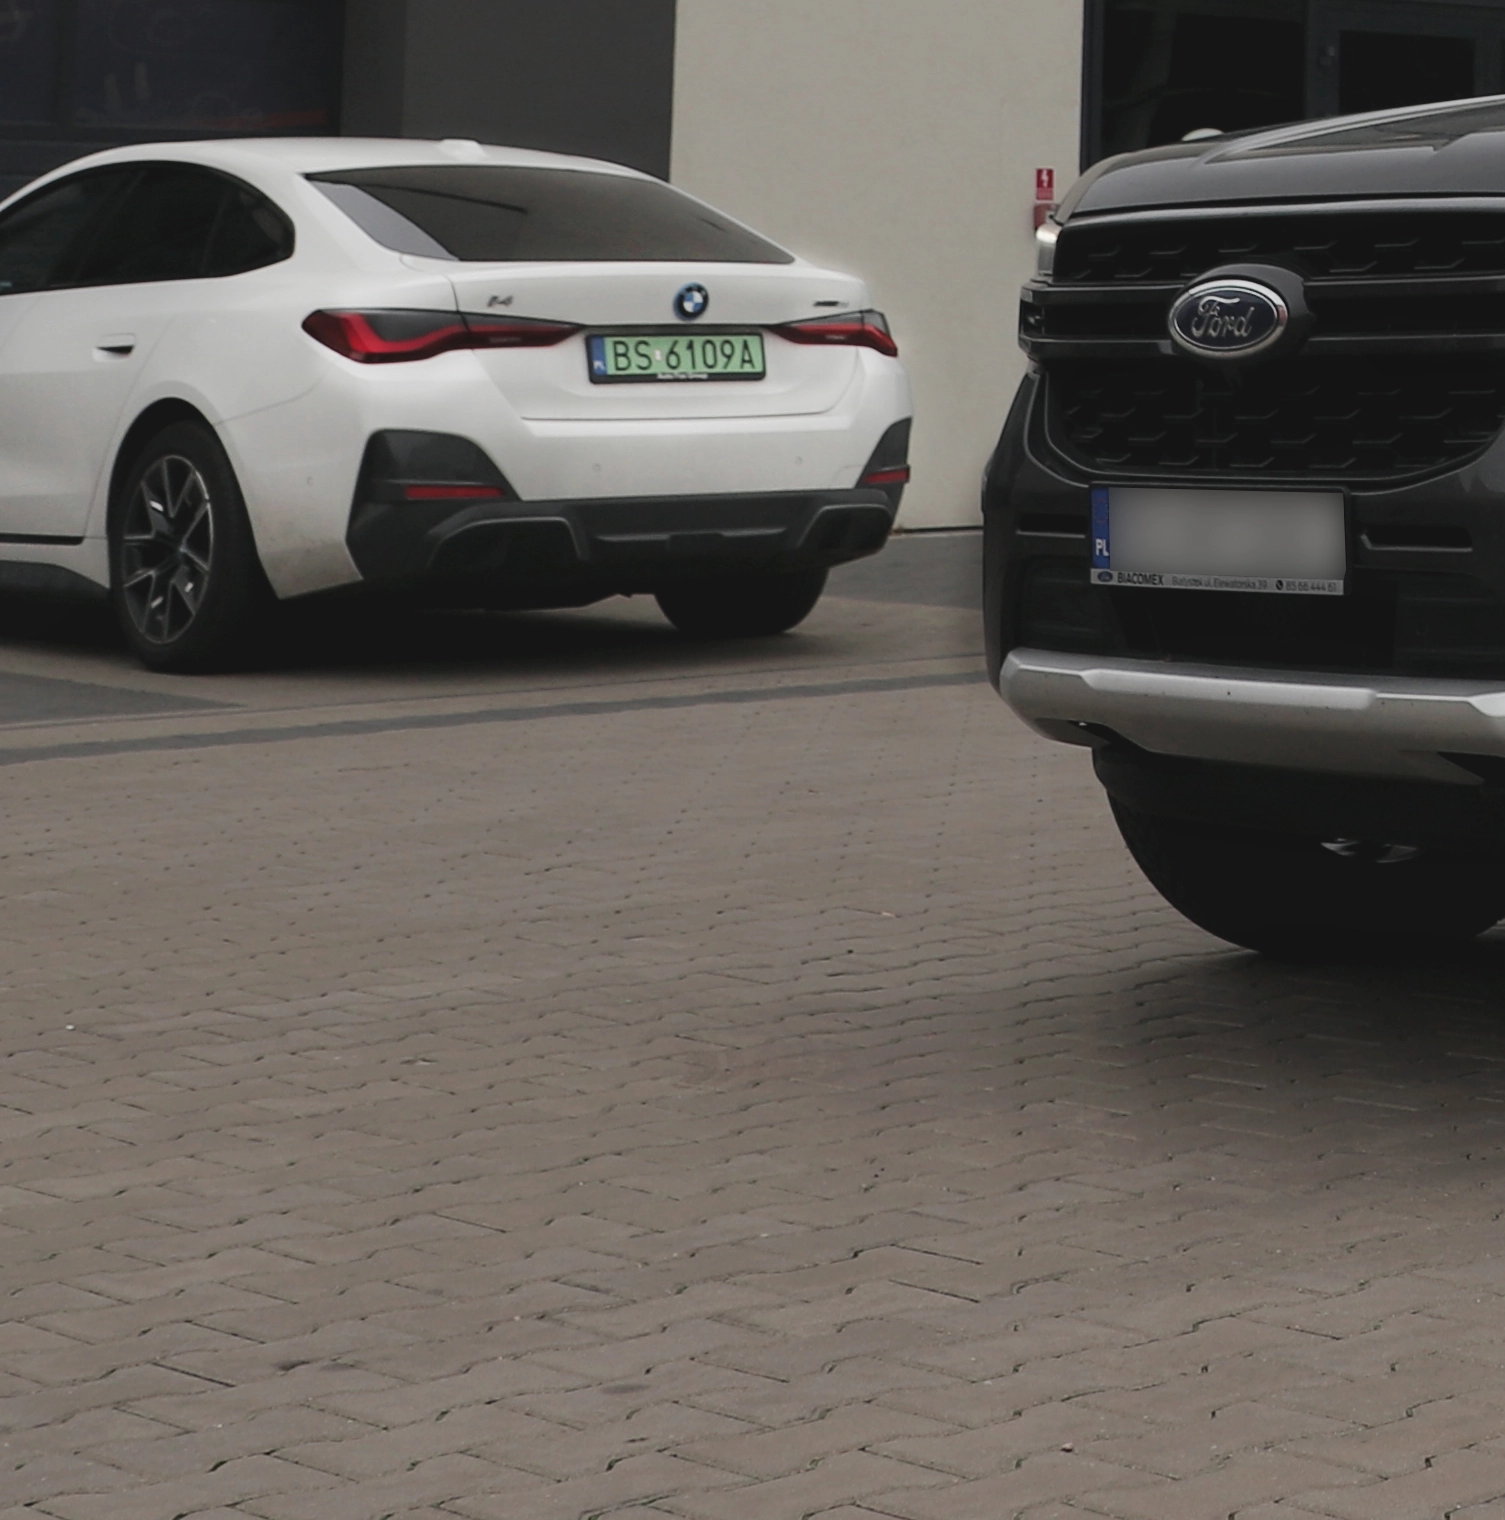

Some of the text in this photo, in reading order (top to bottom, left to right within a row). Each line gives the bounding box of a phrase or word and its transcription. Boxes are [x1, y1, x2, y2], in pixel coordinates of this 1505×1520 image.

[1191, 295, 1254, 338] Ford
[612, 339, 756, 372] BS 6109A
[1095, 538, 1110, 557] PL
[1117, 571, 1164, 586] BIACOMEX
